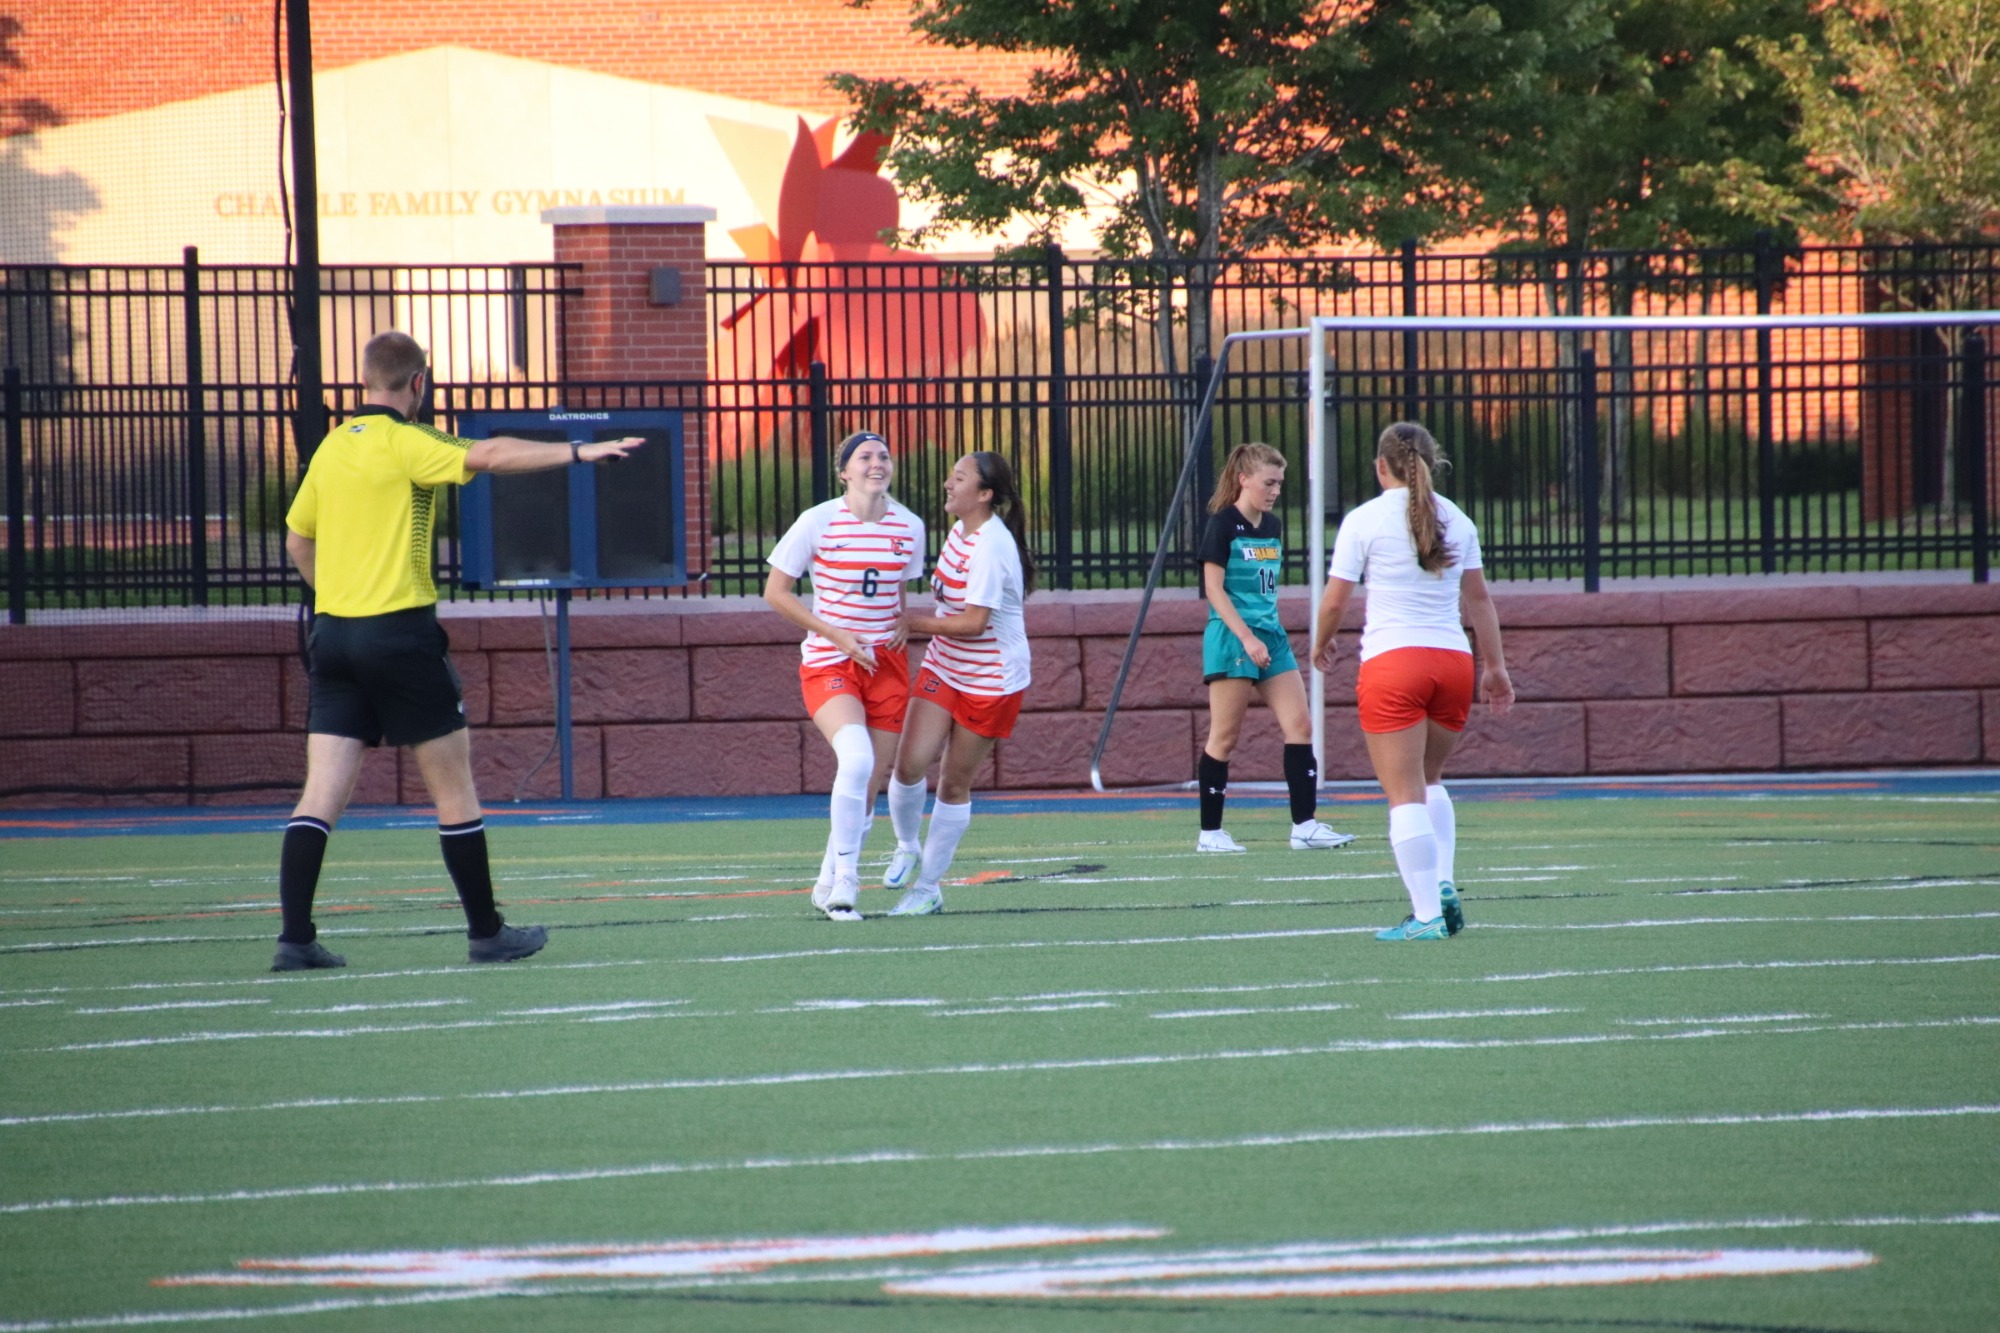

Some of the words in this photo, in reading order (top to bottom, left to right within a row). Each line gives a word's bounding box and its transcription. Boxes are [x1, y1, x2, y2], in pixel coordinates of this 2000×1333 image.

[368, 190, 480, 217] FAMILY
[491, 188, 686, 215] GYMNASIUM
[549, 412, 609, 421] DAKTRONICS
[862, 567, 880, 598] 6
[1259, 568, 1276, 595] 14
